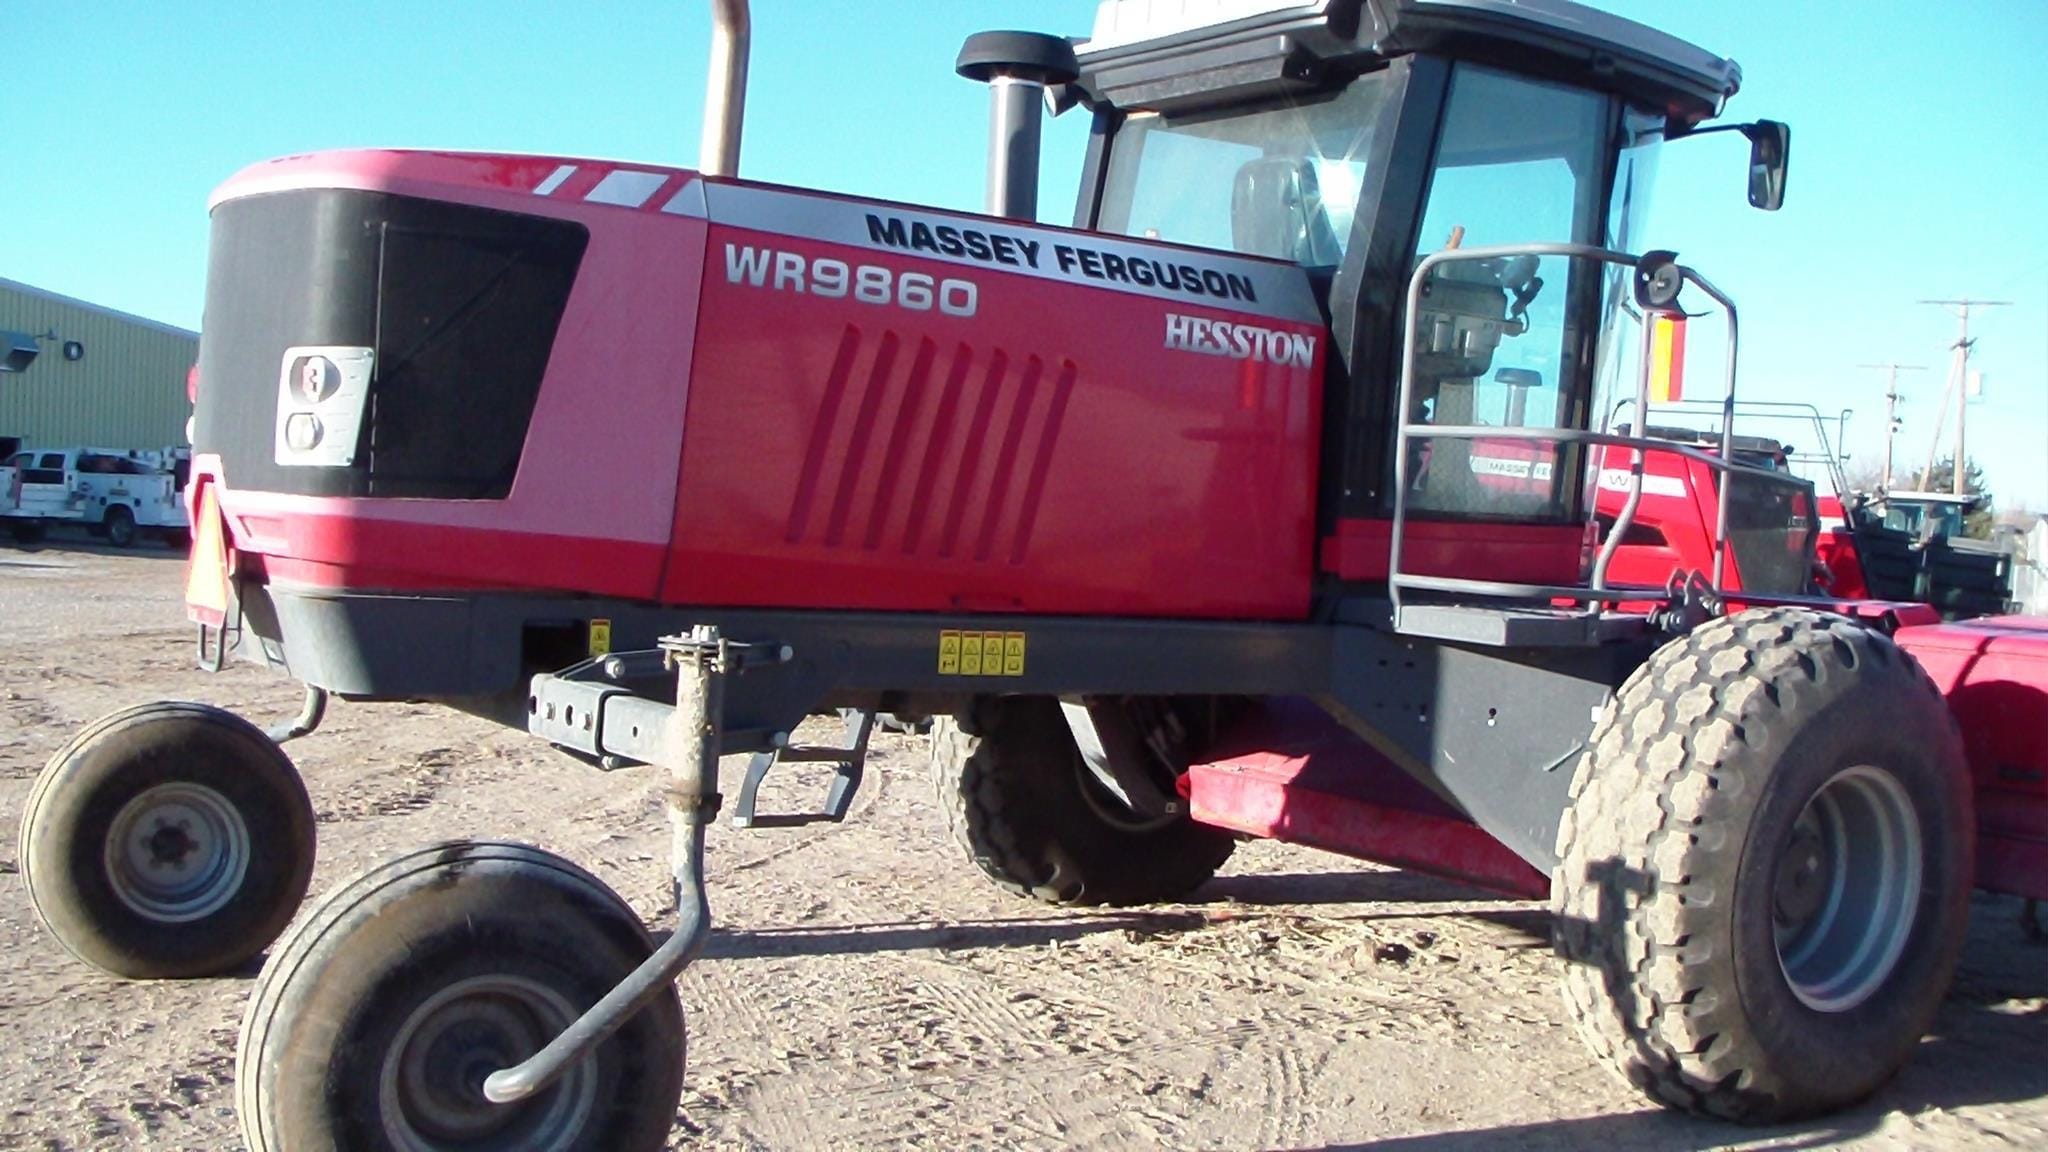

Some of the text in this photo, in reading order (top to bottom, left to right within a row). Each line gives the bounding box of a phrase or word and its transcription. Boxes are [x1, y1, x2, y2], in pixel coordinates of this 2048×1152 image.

[725, 243, 979, 317] WR9860
[866, 214, 1257, 302] MASSEY FERGUSON
[1164, 313, 1316, 368] HESSTON
